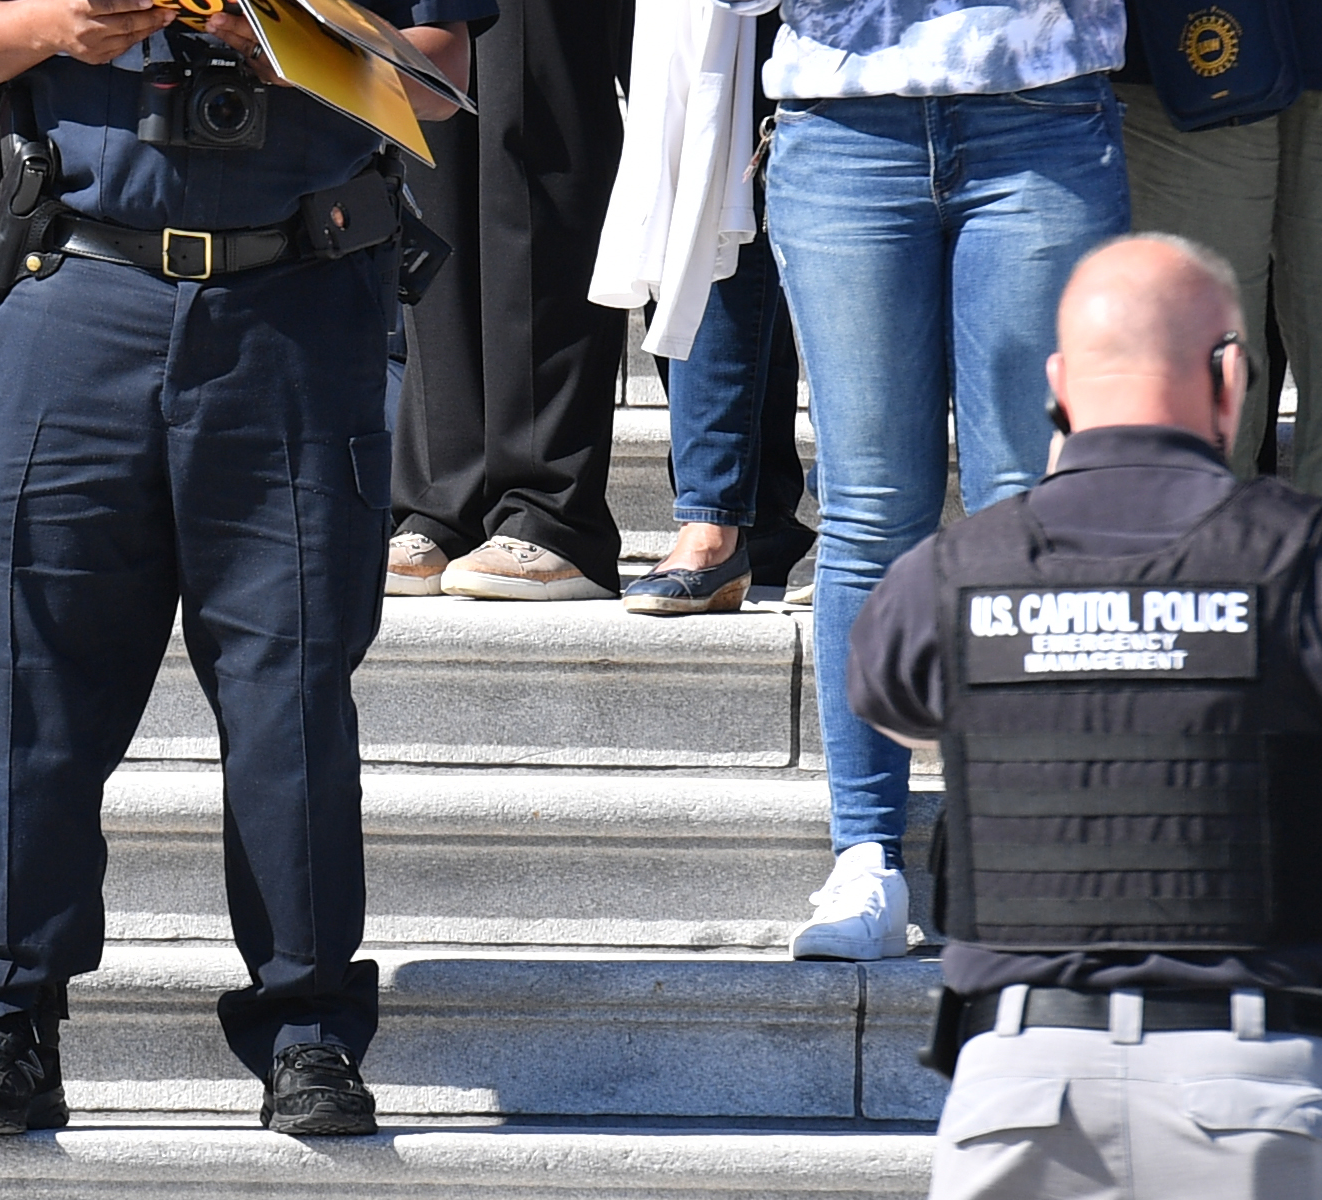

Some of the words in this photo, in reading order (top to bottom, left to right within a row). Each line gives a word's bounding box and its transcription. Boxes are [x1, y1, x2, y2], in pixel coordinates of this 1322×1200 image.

[211, 58, 236, 68] Nikon
[970, 595, 1018, 637] U.S.
[1019, 590, 1139, 635] CAPITOL
[1143, 590, 1249, 633] POLICE
[1032, 633, 1179, 653] EMERGENCY
[1024, 650, 1188, 673] MANAGEMENT
